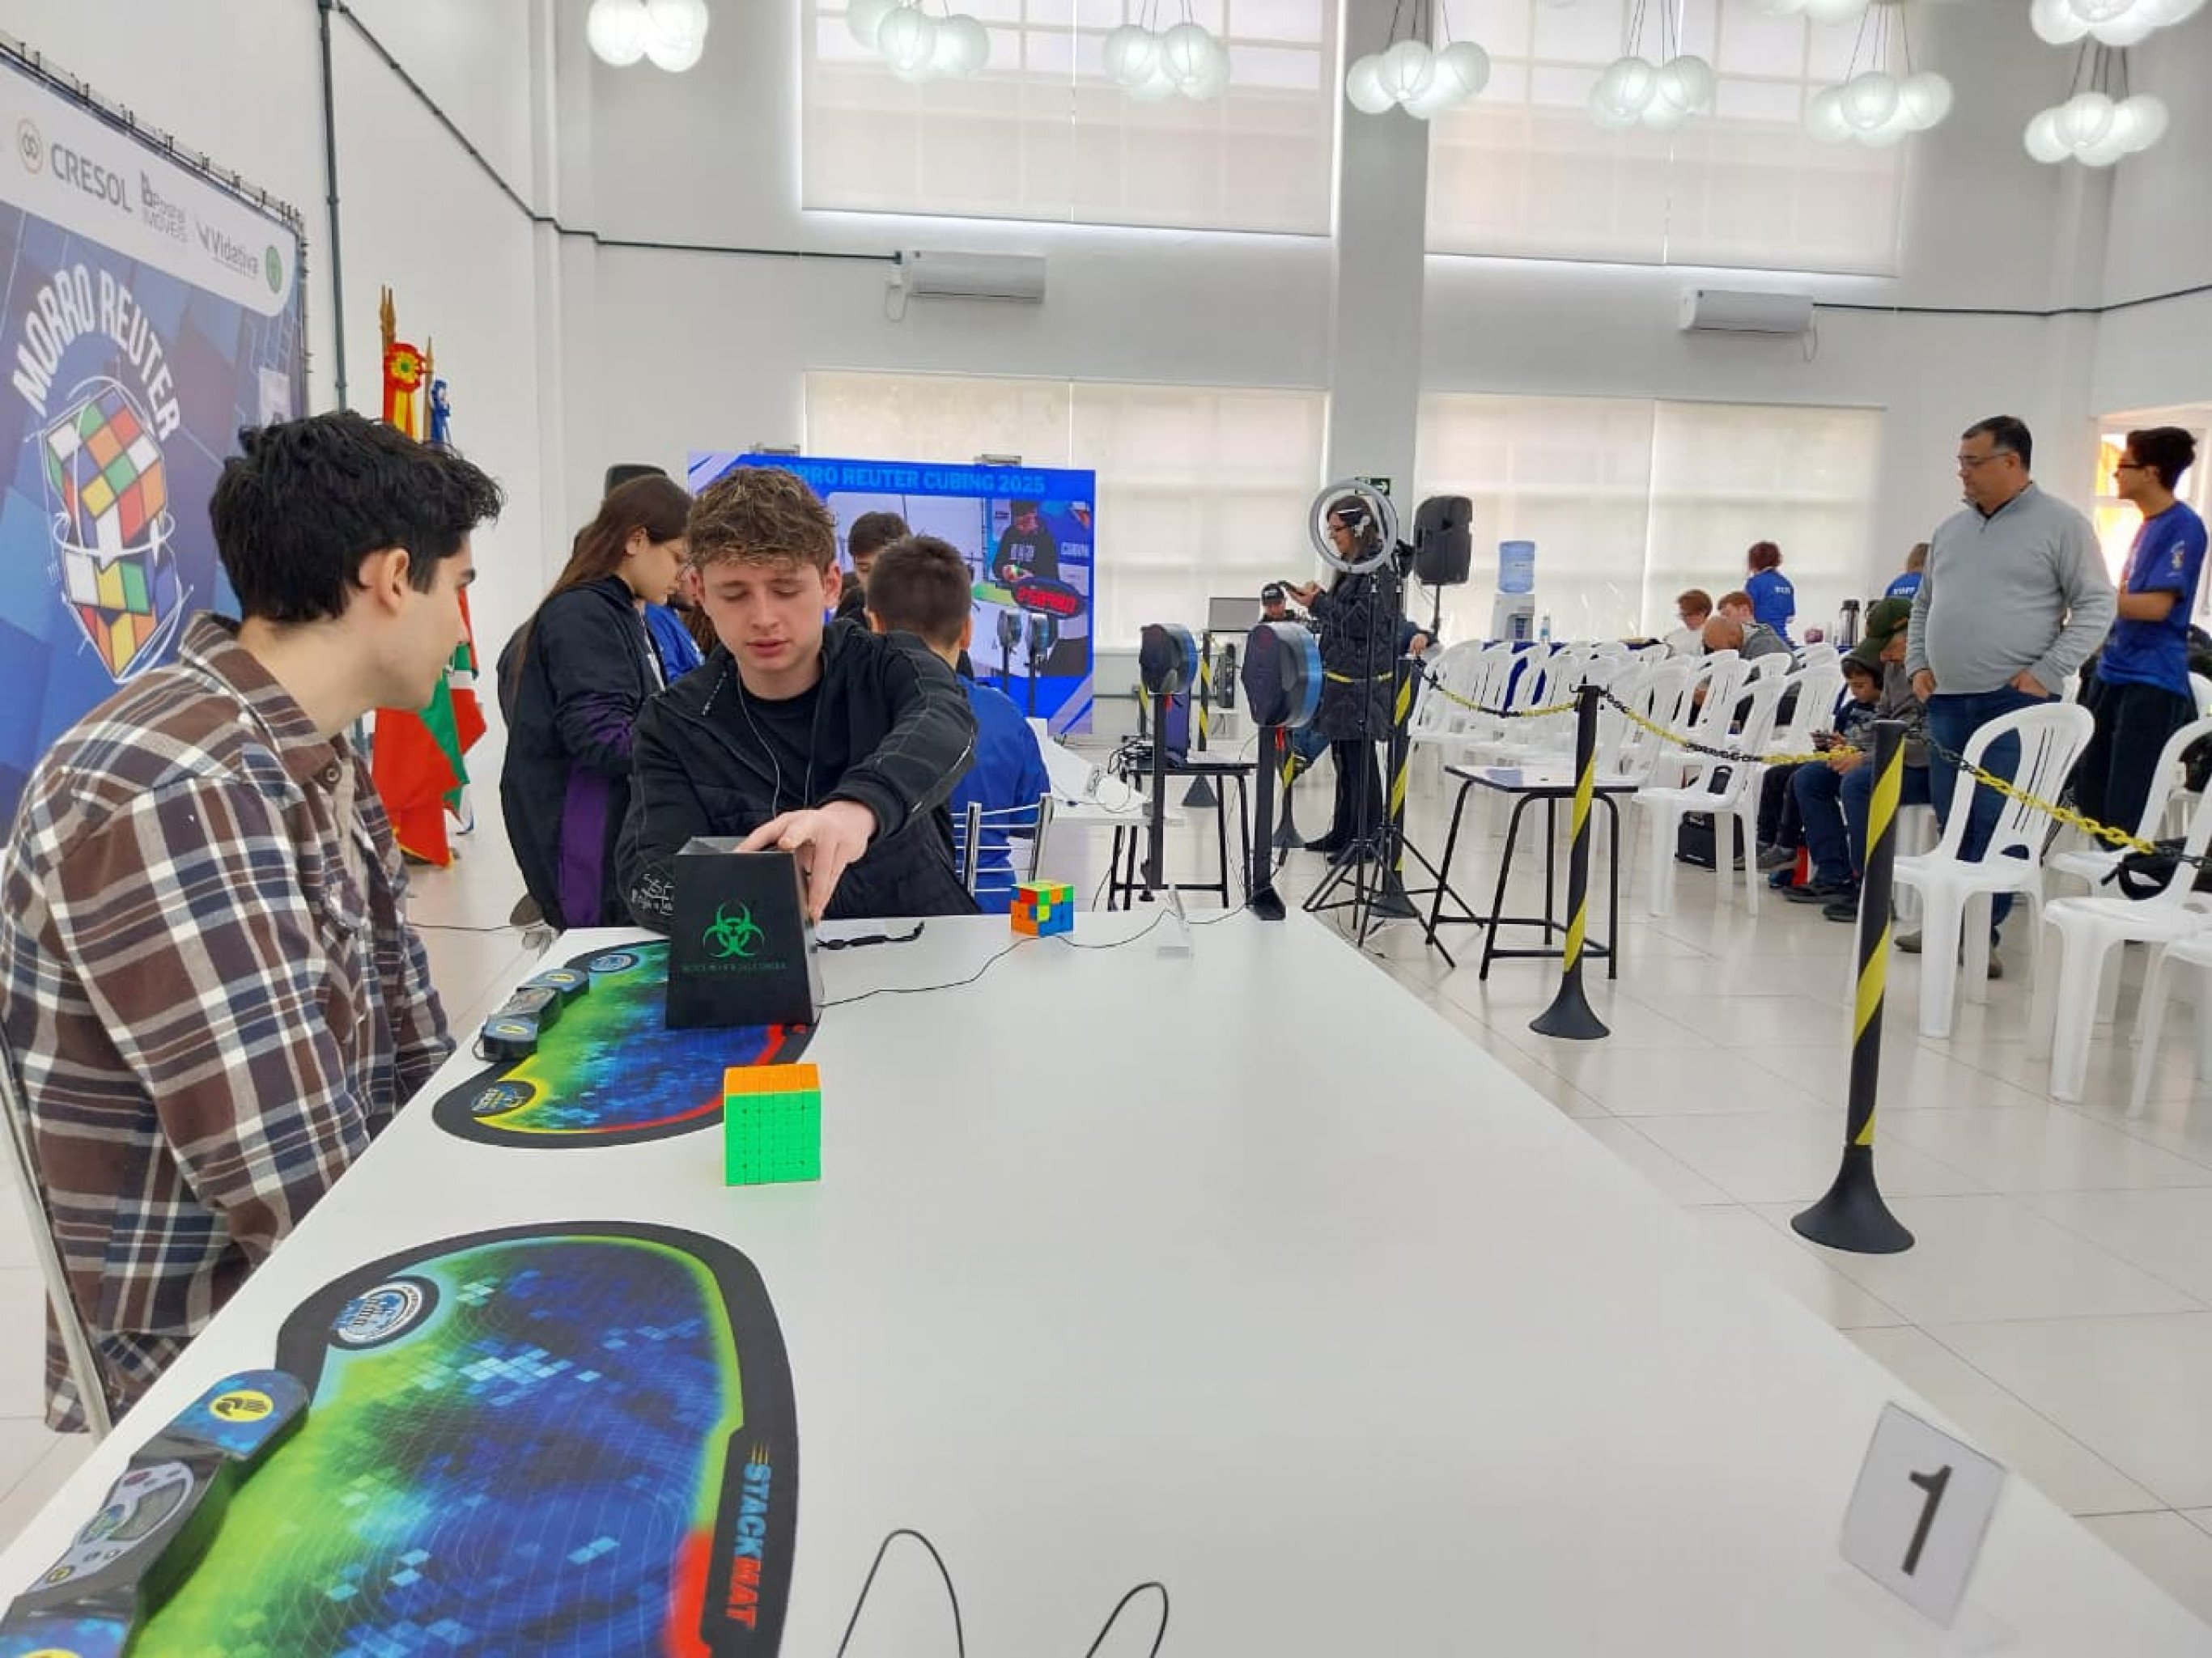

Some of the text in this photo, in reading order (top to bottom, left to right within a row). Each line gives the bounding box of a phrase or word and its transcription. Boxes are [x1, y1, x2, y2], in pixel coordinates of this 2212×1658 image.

[50, 142, 133, 214] CRESOL
[12, 263, 180, 441] MORRO REUTER
[842, 467, 919, 489] REUTER
[923, 470, 995, 491] CUBING
[998, 473, 1047, 494] 2025
[1901, 1464, 1953, 1577] 1
